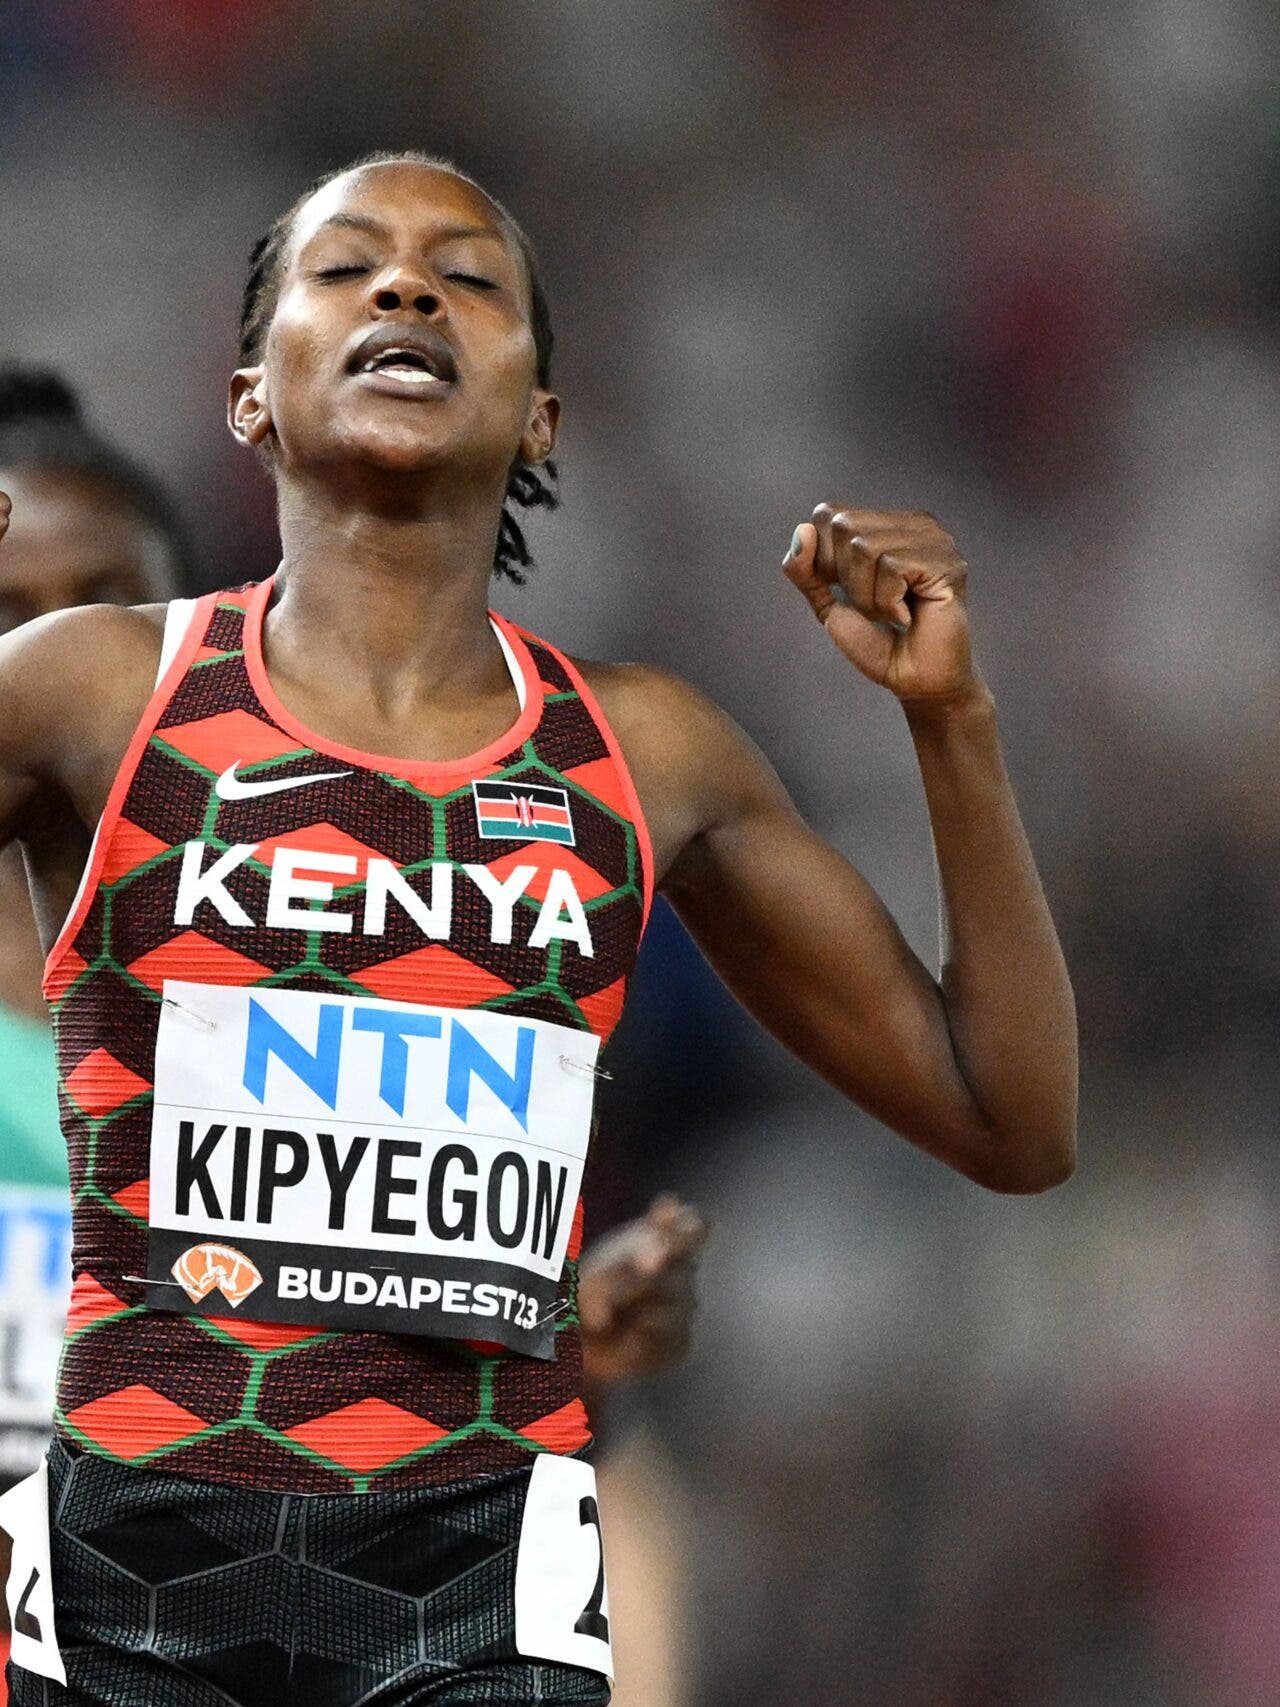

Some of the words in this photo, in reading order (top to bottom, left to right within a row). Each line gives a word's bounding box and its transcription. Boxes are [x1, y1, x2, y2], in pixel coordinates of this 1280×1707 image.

[174, 842, 594, 958] KENYA
[243, 997, 536, 1133] NTN
[175, 1121, 568, 1260] KIPYEGON
